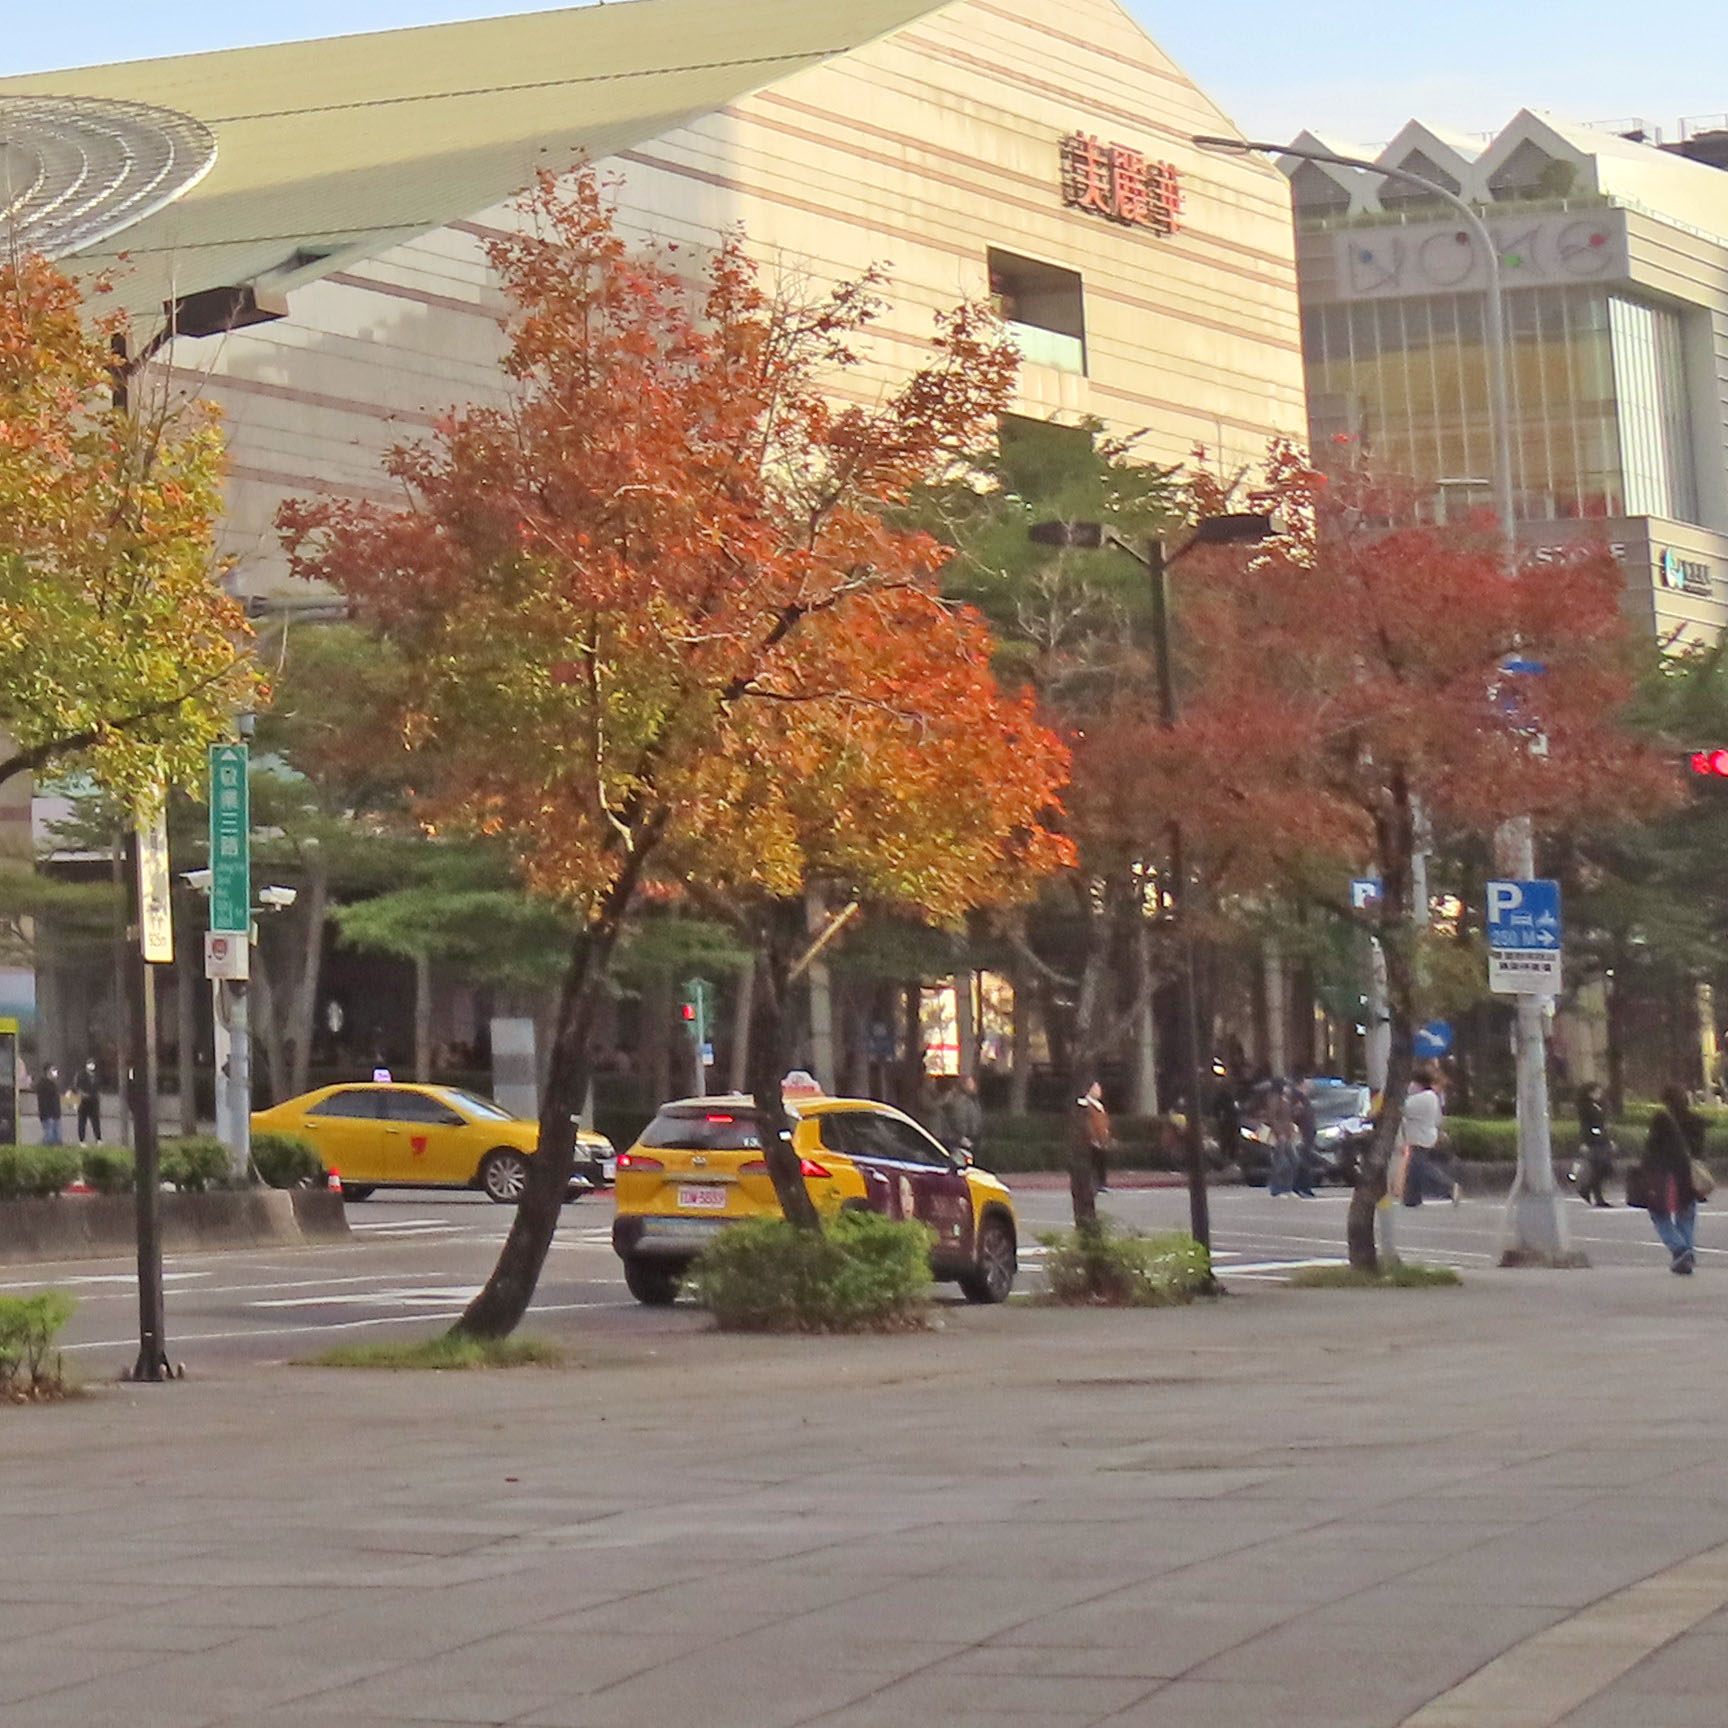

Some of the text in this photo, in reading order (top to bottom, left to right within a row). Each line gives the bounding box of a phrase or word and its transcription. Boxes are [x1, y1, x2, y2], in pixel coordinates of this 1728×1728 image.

[1060, 130, 1185, 236] 美麗華
[1487, 881, 1523, 924] P
